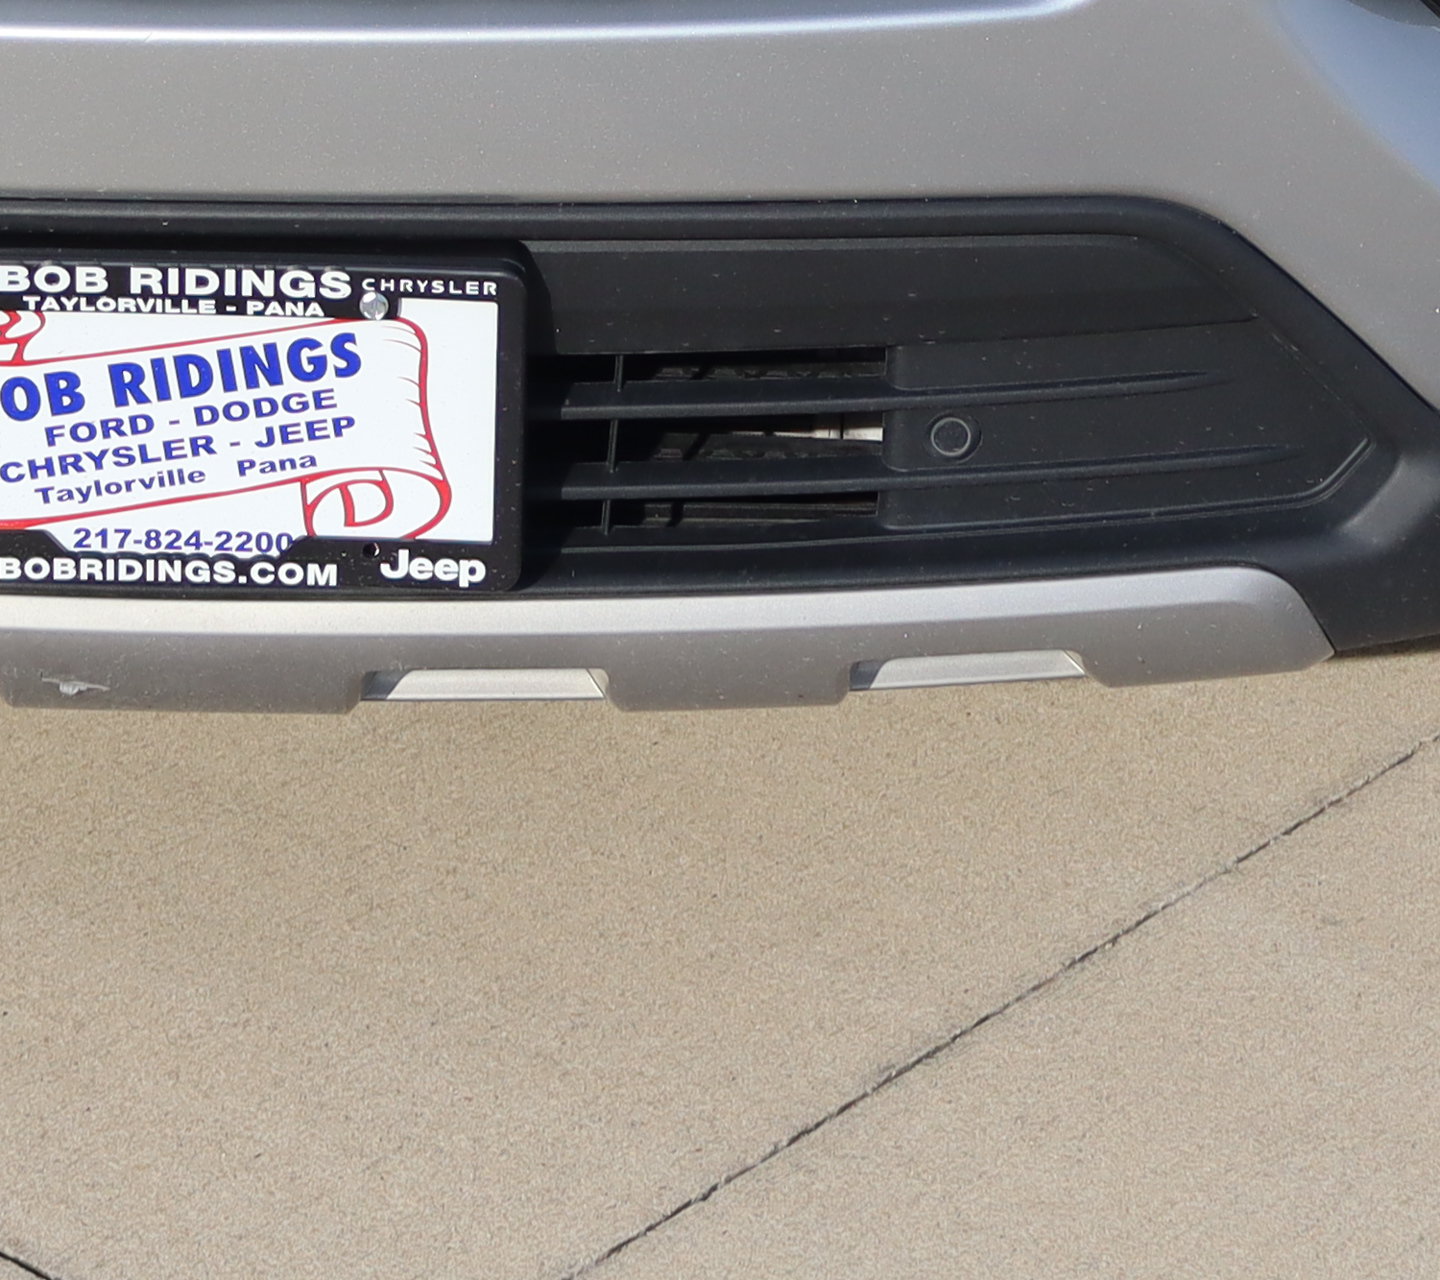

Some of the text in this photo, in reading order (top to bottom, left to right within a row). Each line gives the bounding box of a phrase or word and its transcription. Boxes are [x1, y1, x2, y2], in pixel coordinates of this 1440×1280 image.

[129, 266, 352, 299] RIDINGS
[361, 277, 497, 296] CHRYSLER
[22, 295, 216, 315] TAYLORVILLE
[246, 300, 325, 318] PANA
[107, 332, 362, 408] RIDINGS
[44, 414, 155, 447] FORD
[193, 388, 337, 427] DODGE
[0, 435, 218, 483] CHRYSLER
[254, 416, 356, 448] JEEP
[34, 454, 318, 505] Taylorville Pana
[73, 527, 293, 556] 217-824-2200
[380, 549, 486, 588] Jeep
